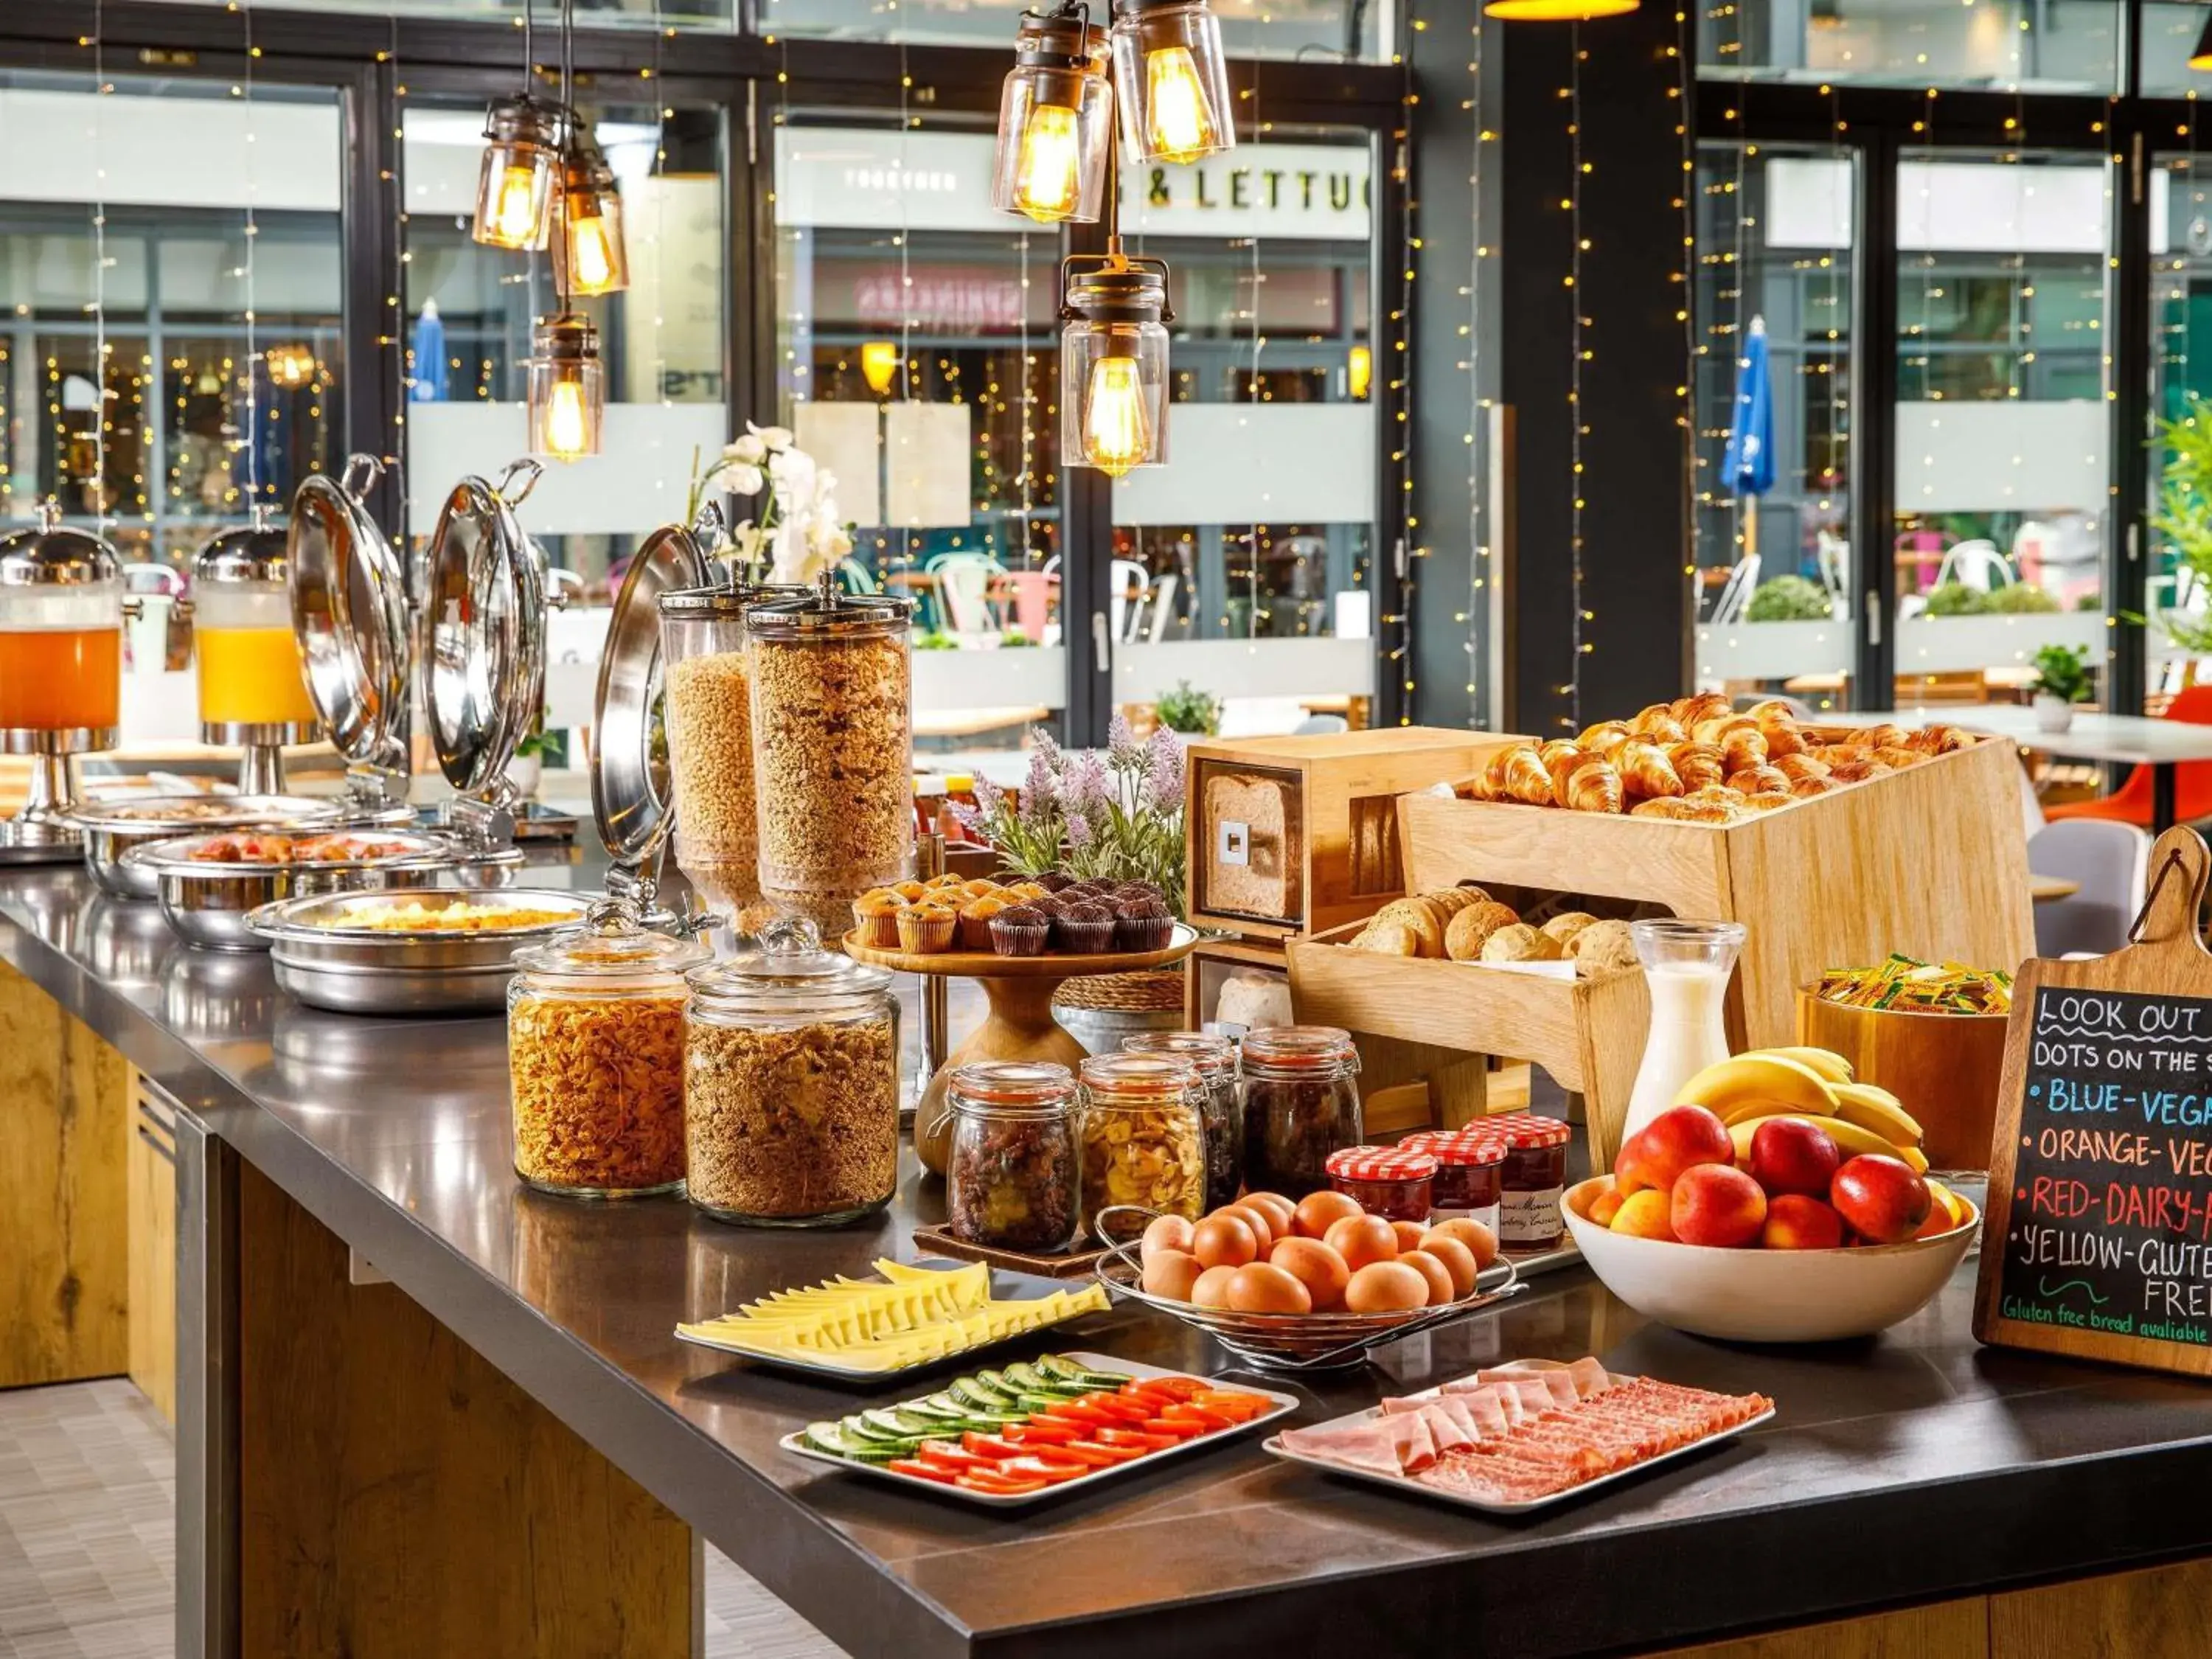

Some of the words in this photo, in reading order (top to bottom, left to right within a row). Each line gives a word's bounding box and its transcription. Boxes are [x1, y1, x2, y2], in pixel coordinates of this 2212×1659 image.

[1150, 167, 1170, 206] &
[2039, 993, 2126, 1030] LOOK
[2140, 1005, 2201, 1032] OUT
[2034, 1041, 2099, 1067] DOTS
[2107, 1049, 2143, 1070] ON
[2149, 1050, 2199, 1071] THE
[2003, 1295, 2053, 1322] Gluten
[2057, 1304, 2085, 1326] free
[2090, 1310, 2134, 1333] bread
[2144, 1278, 2212, 1316] FRE
